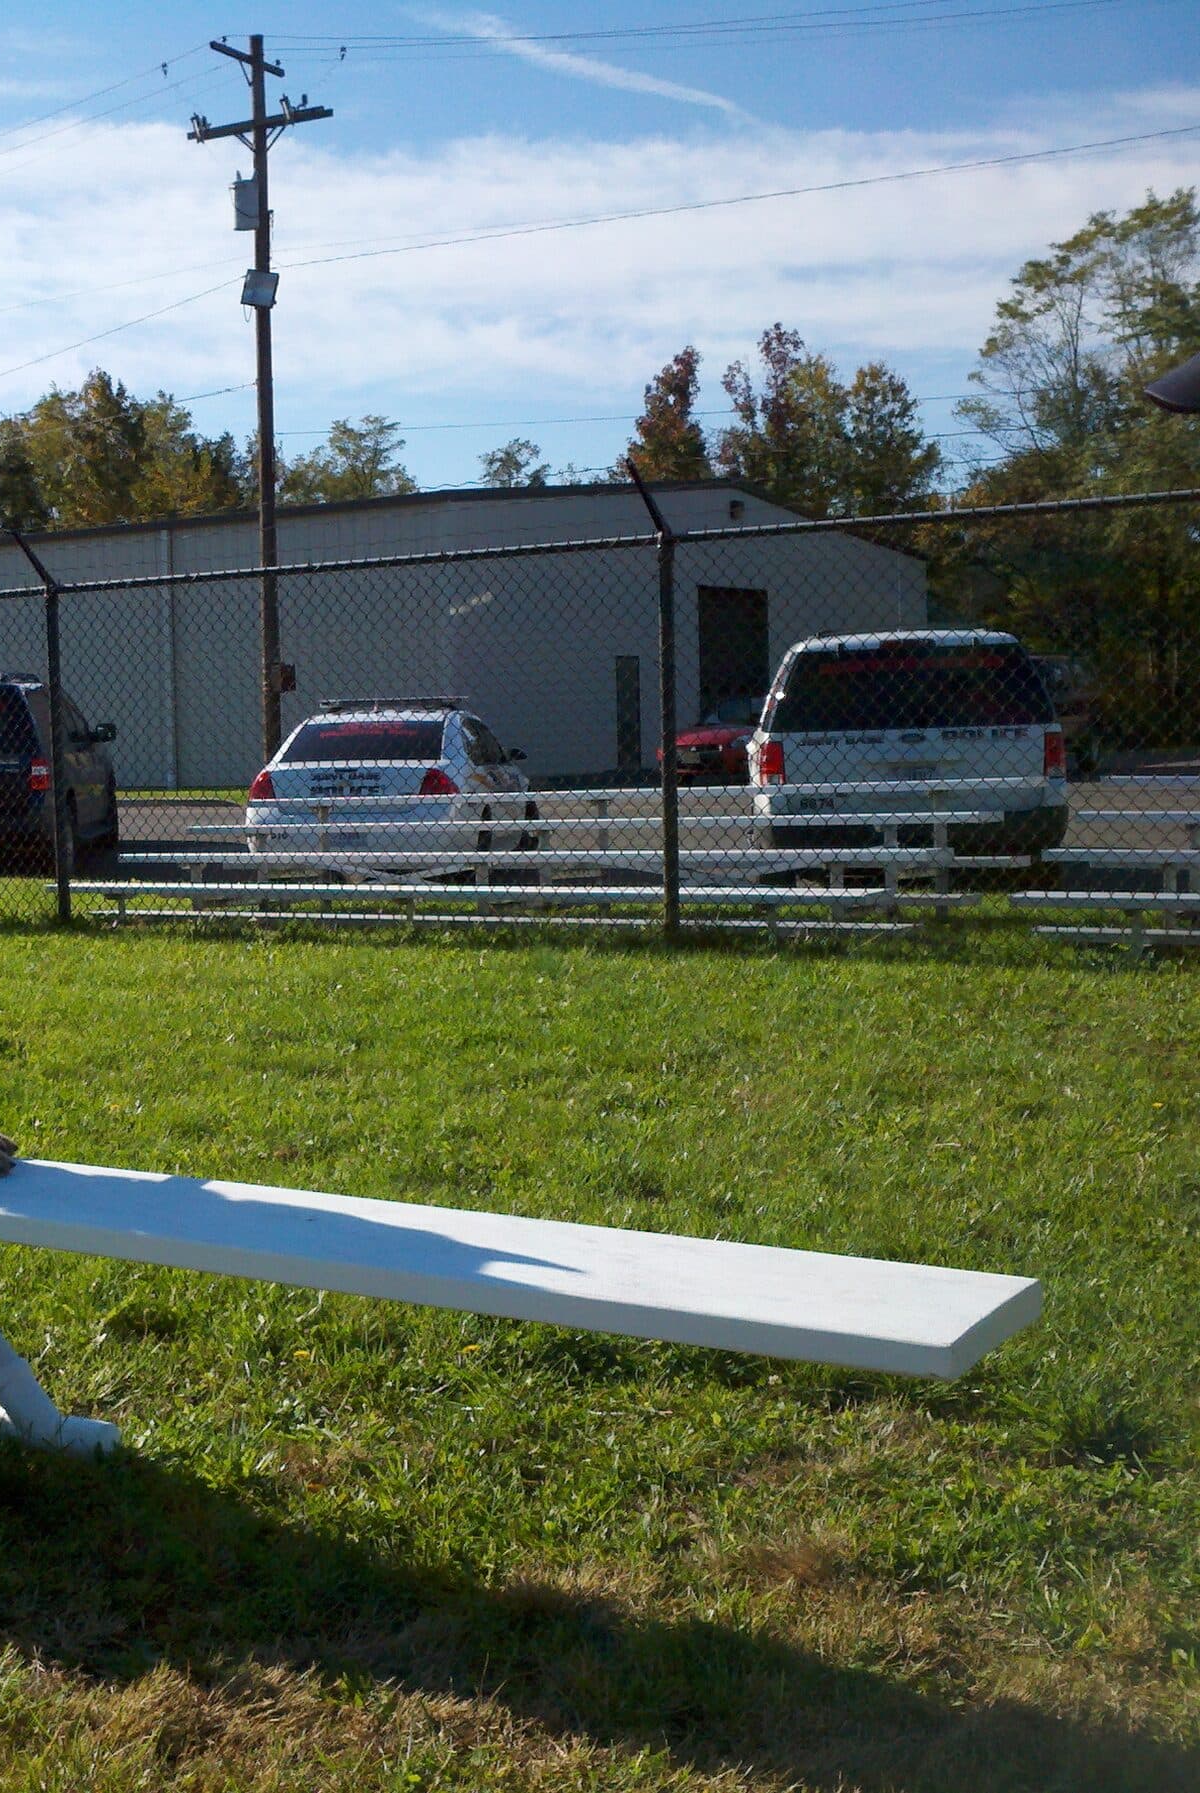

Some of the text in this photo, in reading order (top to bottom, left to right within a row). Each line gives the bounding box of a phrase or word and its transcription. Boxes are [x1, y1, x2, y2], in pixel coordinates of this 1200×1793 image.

[941, 727, 1028, 740] POLICE
[845, 734, 885, 745] BASE
[310, 771, 381, 781] JOINT BASE
[310, 785, 381, 796] POLICE
